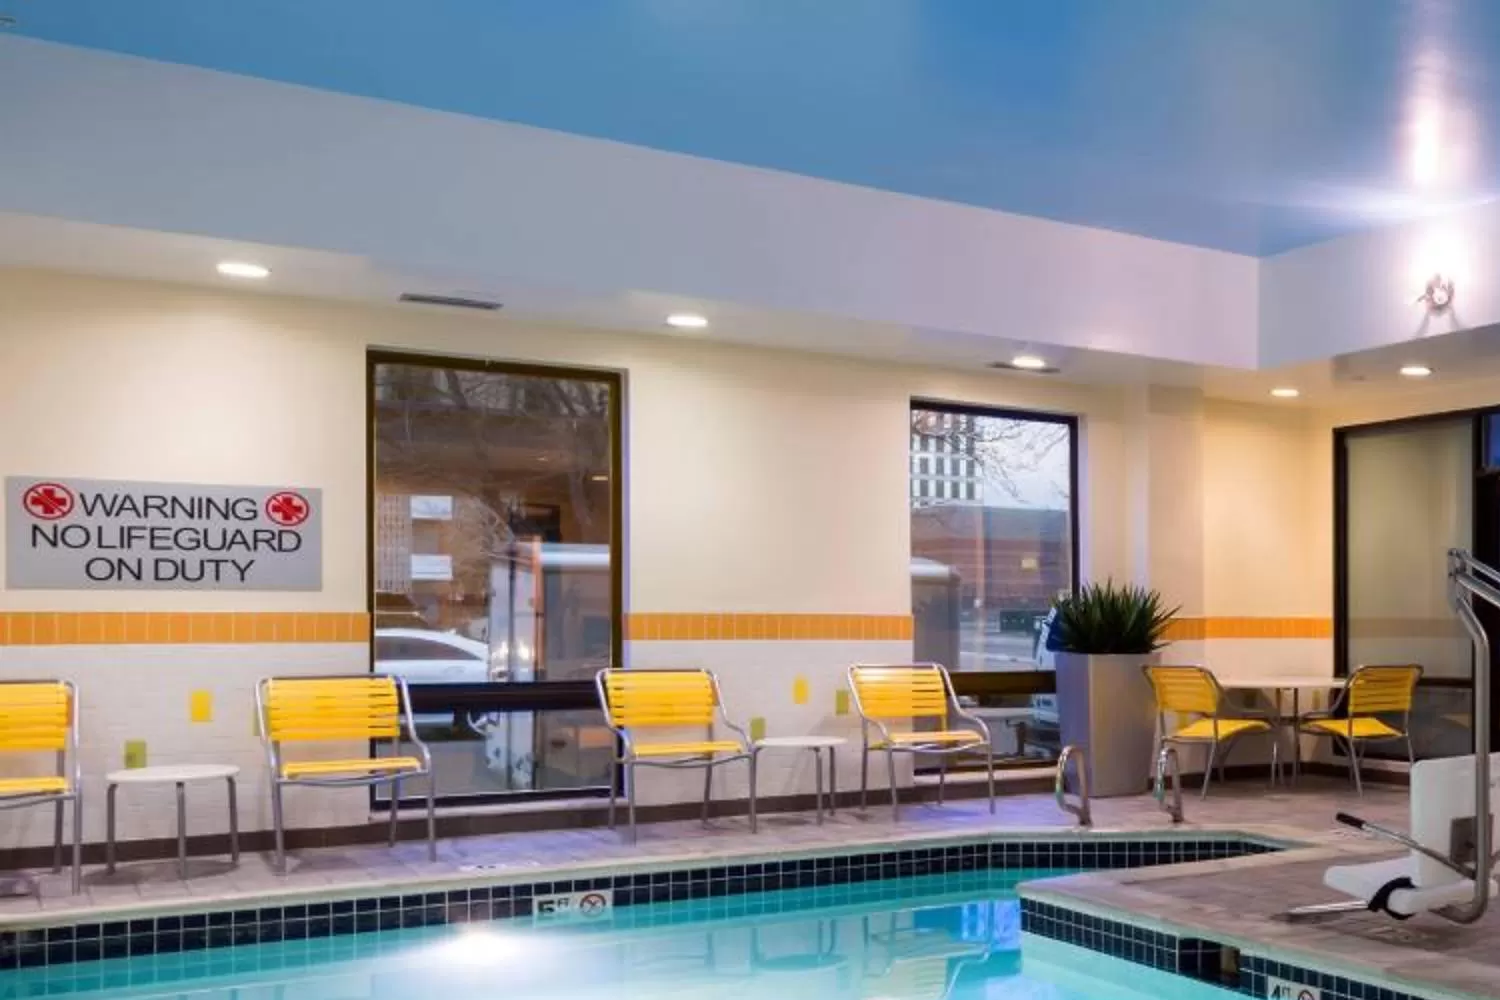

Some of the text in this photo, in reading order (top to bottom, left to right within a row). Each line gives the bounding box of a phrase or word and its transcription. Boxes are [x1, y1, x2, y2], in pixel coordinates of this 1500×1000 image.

[79, 492, 258, 521] WARNING
[31, 524, 302, 552] NO LIFEGUARD
[85, 557, 255, 582] ON DUTY
